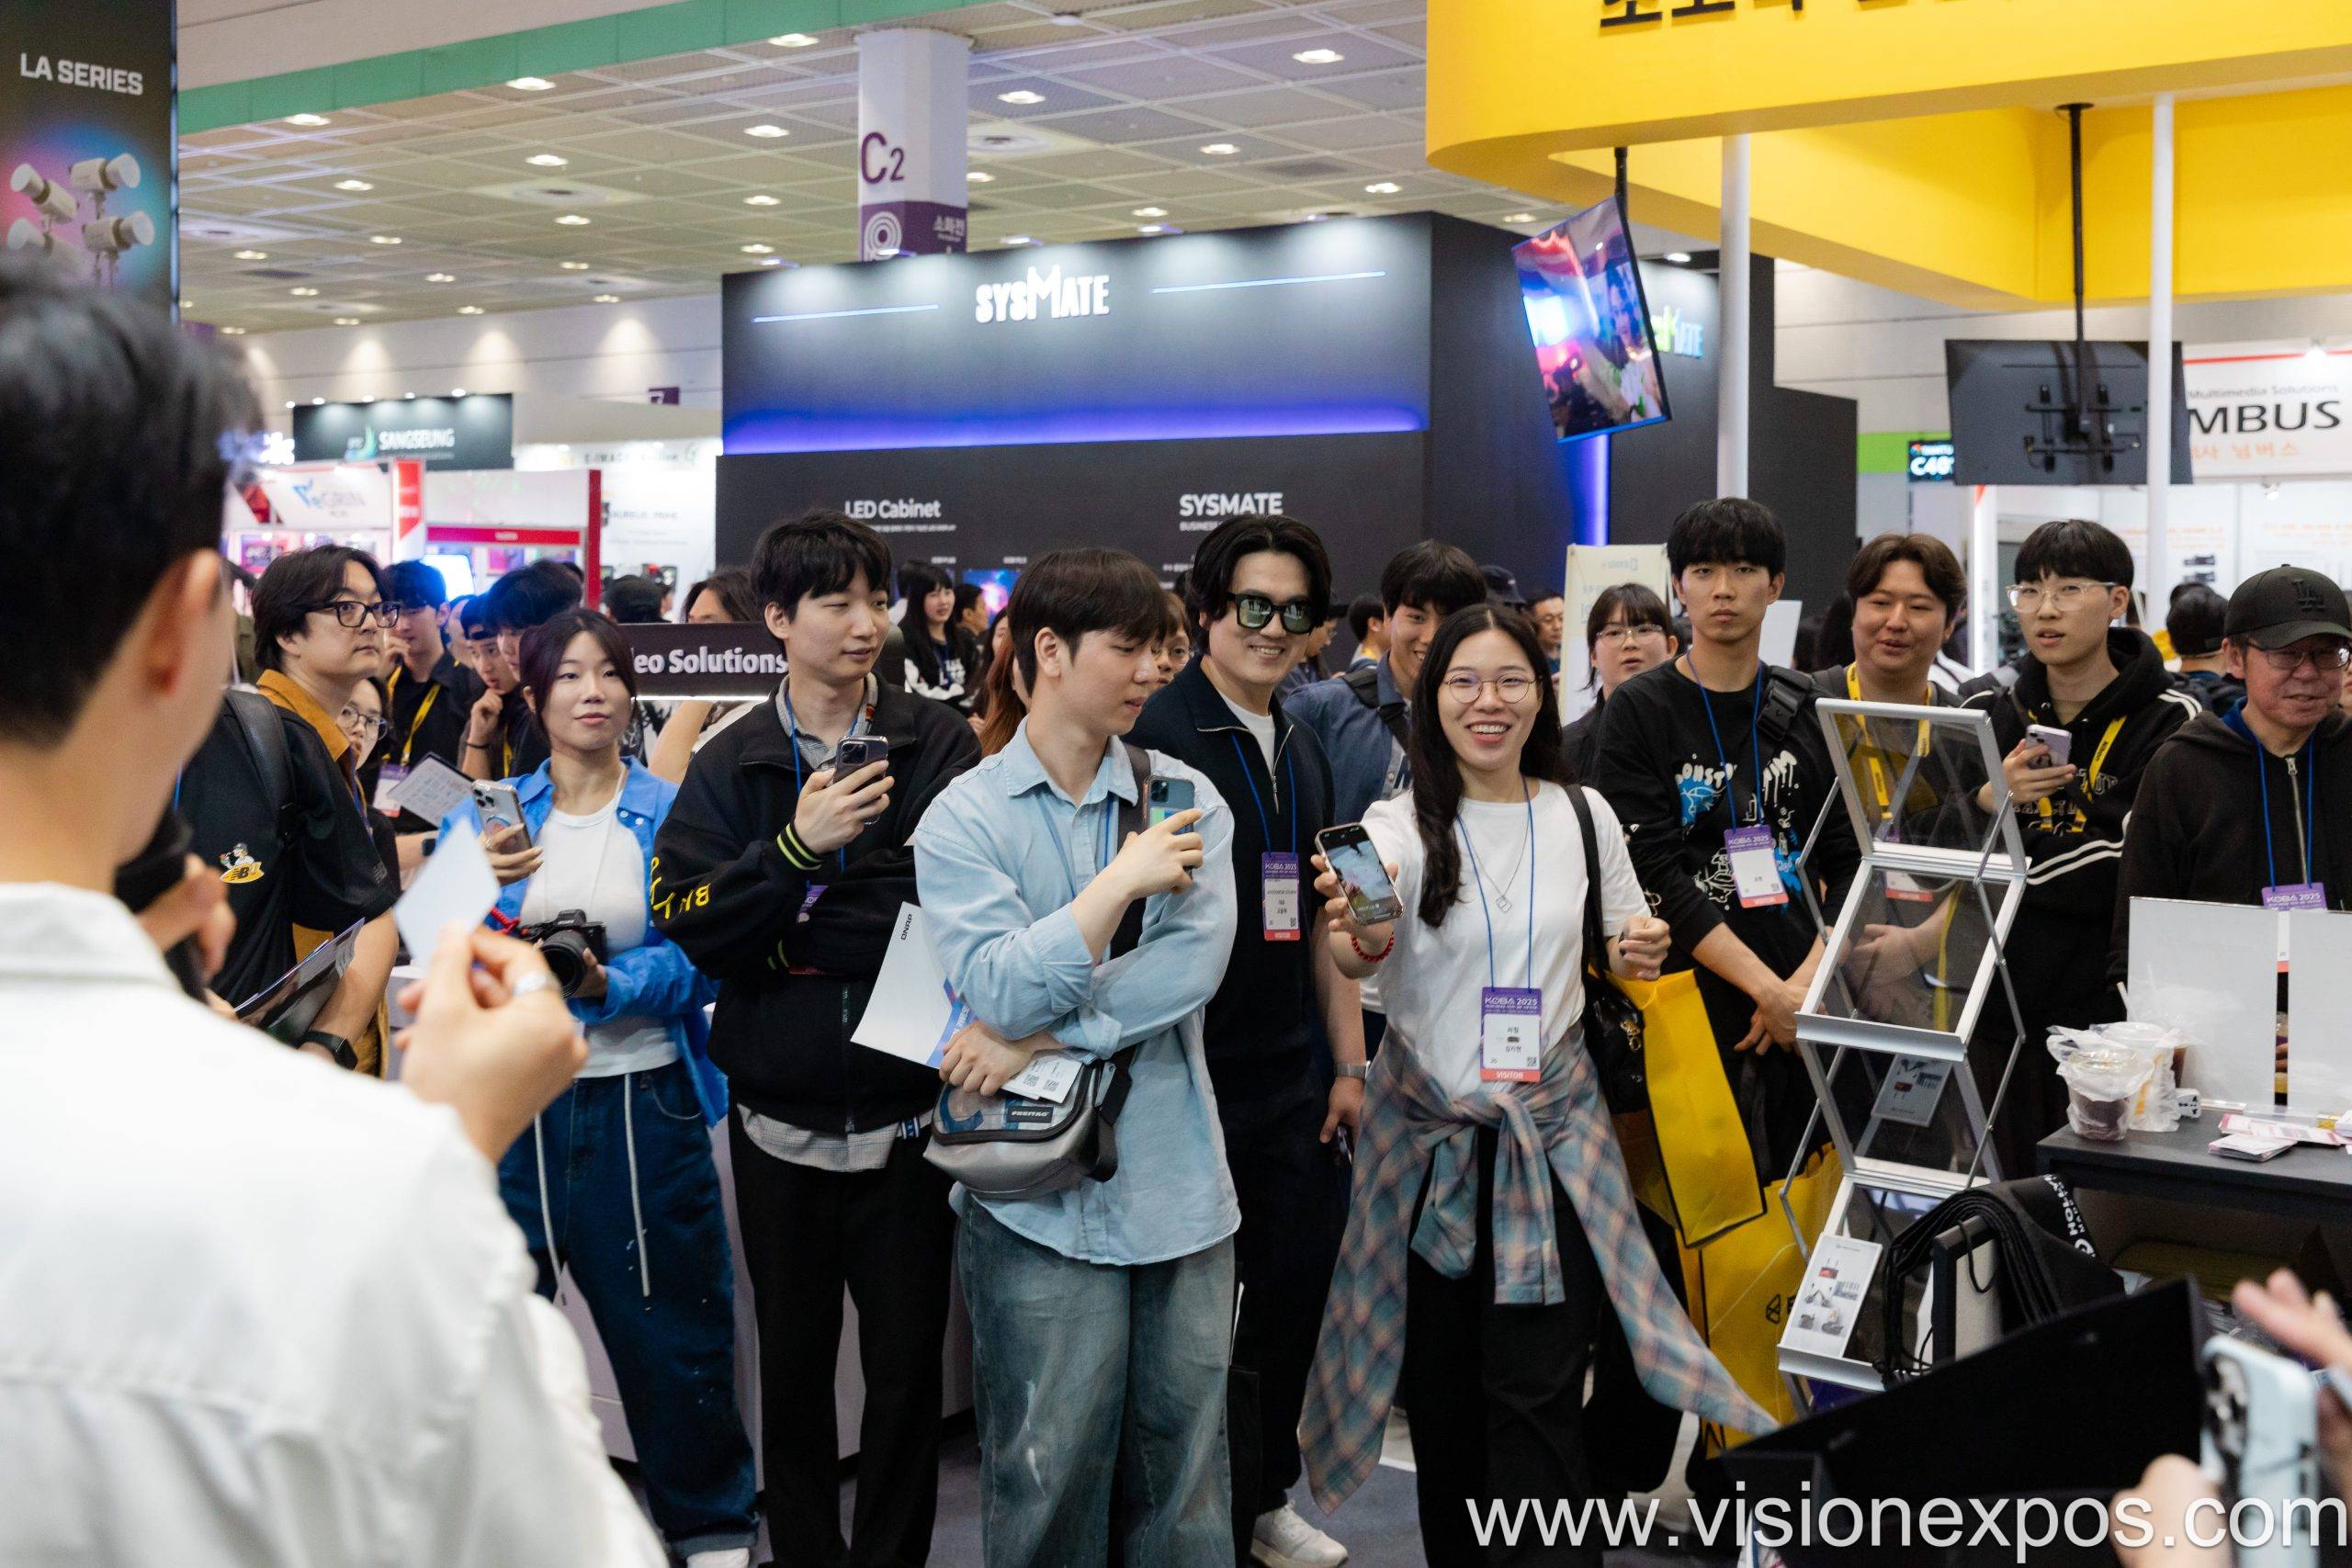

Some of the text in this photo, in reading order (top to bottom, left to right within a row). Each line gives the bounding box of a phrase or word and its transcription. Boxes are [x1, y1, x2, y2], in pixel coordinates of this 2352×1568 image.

[20, 52, 143, 96] LA SERIES
[861, 131, 905, 185] C2
[975, 264, 1111, 323] SYSMATE
[844, 498, 942, 520] LED Cabinet
[1179, 492, 1283, 516] SYSMATE
[669, 646, 789, 674] Solutions
